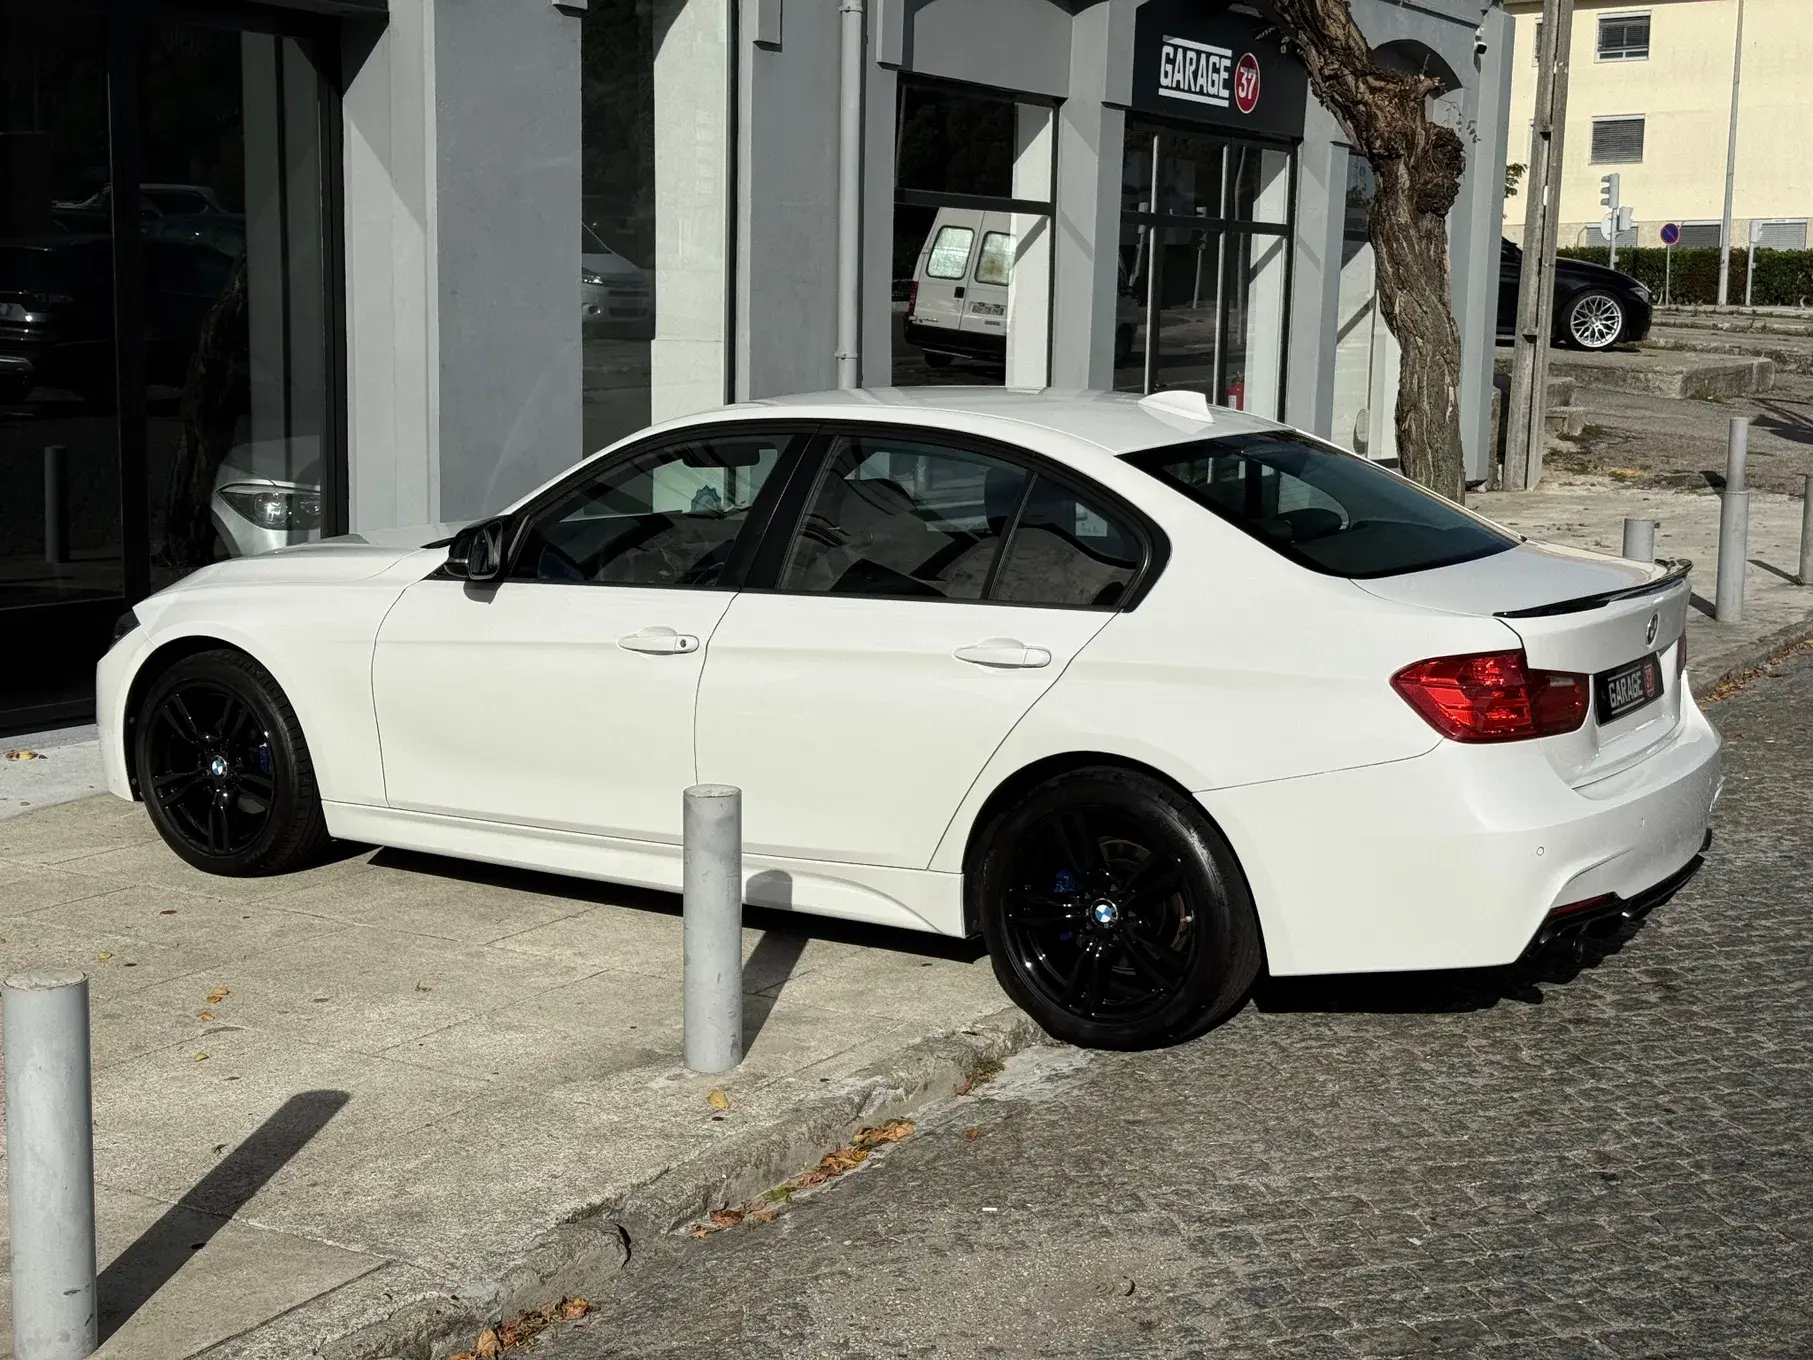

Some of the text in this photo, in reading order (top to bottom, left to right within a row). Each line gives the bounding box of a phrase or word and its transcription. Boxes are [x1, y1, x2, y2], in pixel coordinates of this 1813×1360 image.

[1160, 45, 1256, 100] GARAGE 37
[1608, 671, 1643, 708] GARAGE
